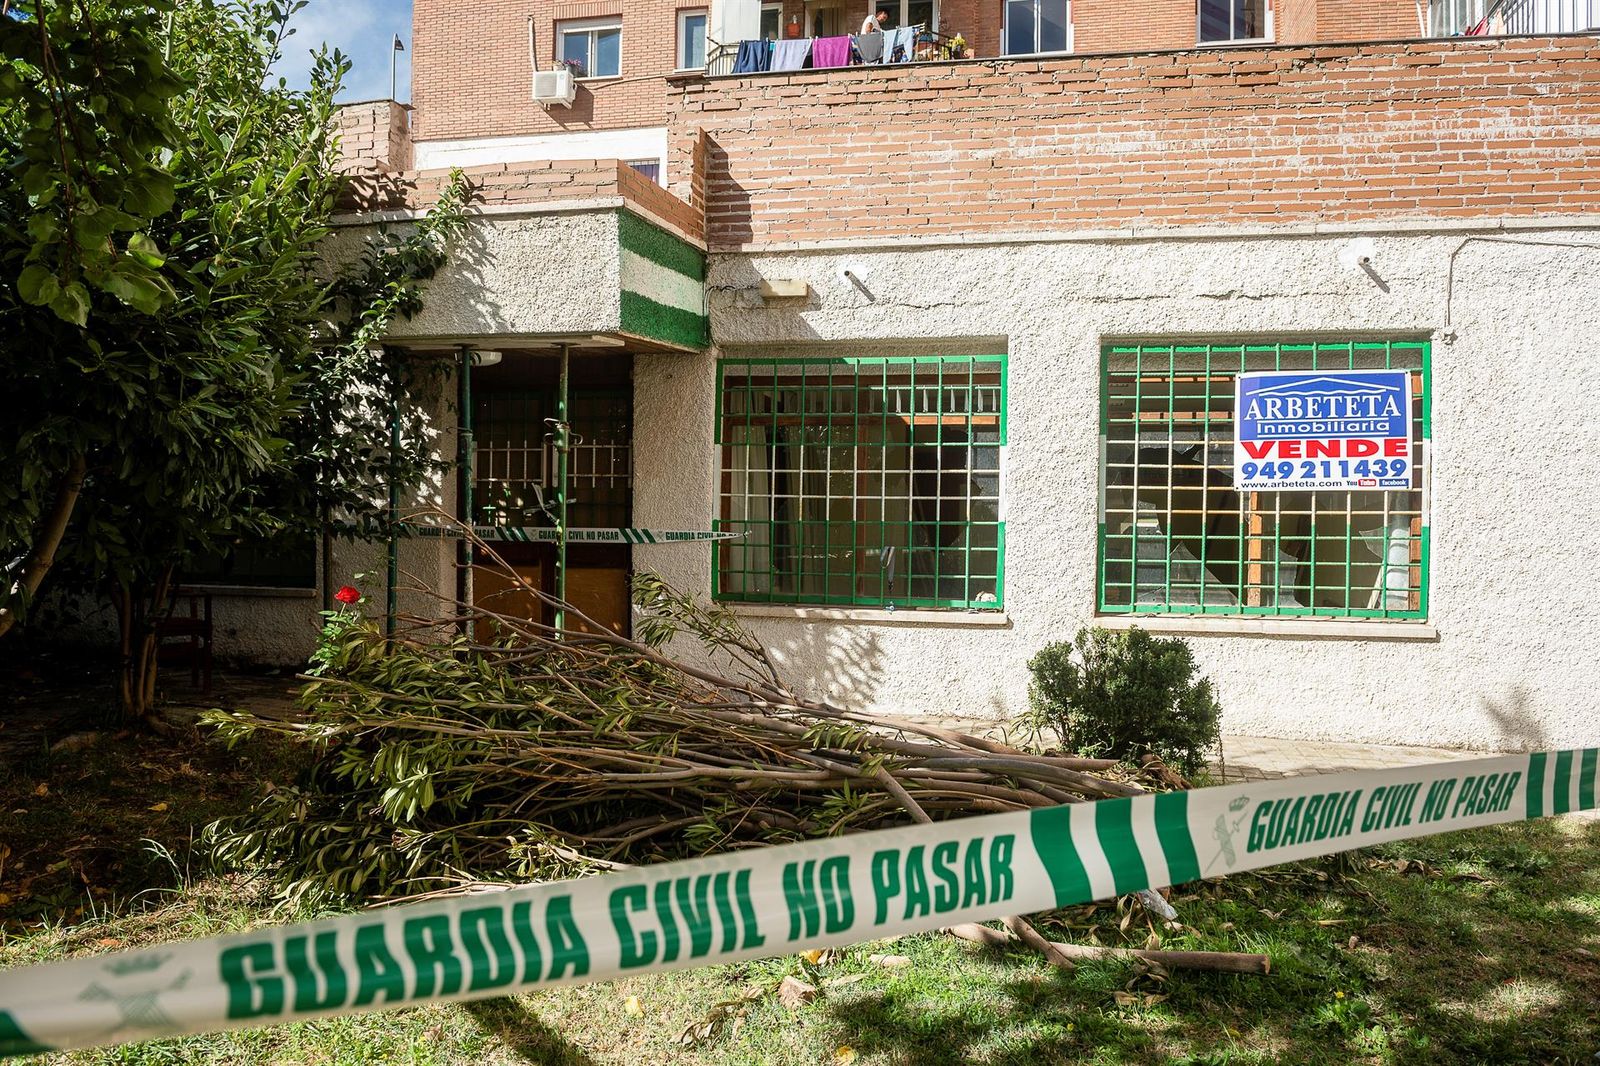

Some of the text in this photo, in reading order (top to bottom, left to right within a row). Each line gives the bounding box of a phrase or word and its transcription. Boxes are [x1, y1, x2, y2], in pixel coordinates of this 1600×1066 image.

[1244, 394, 1402, 421] ARBETETA
[1256, 420, 1390, 434] Inmobiliaria
[1240, 438, 1408, 460] VENDE
[1241, 480, 1342, 489] www.arbeteta.com
[568, 531, 585, 540] CIVIL
[597, 531, 619, 540] PASAR
[665, 531, 695, 541] GUARDIA
[1246, 771, 1522, 853] GUARDIA CIVIL NO PASAR
[219, 834, 1016, 1020] GUARDIA CIVIL NO PASAR
